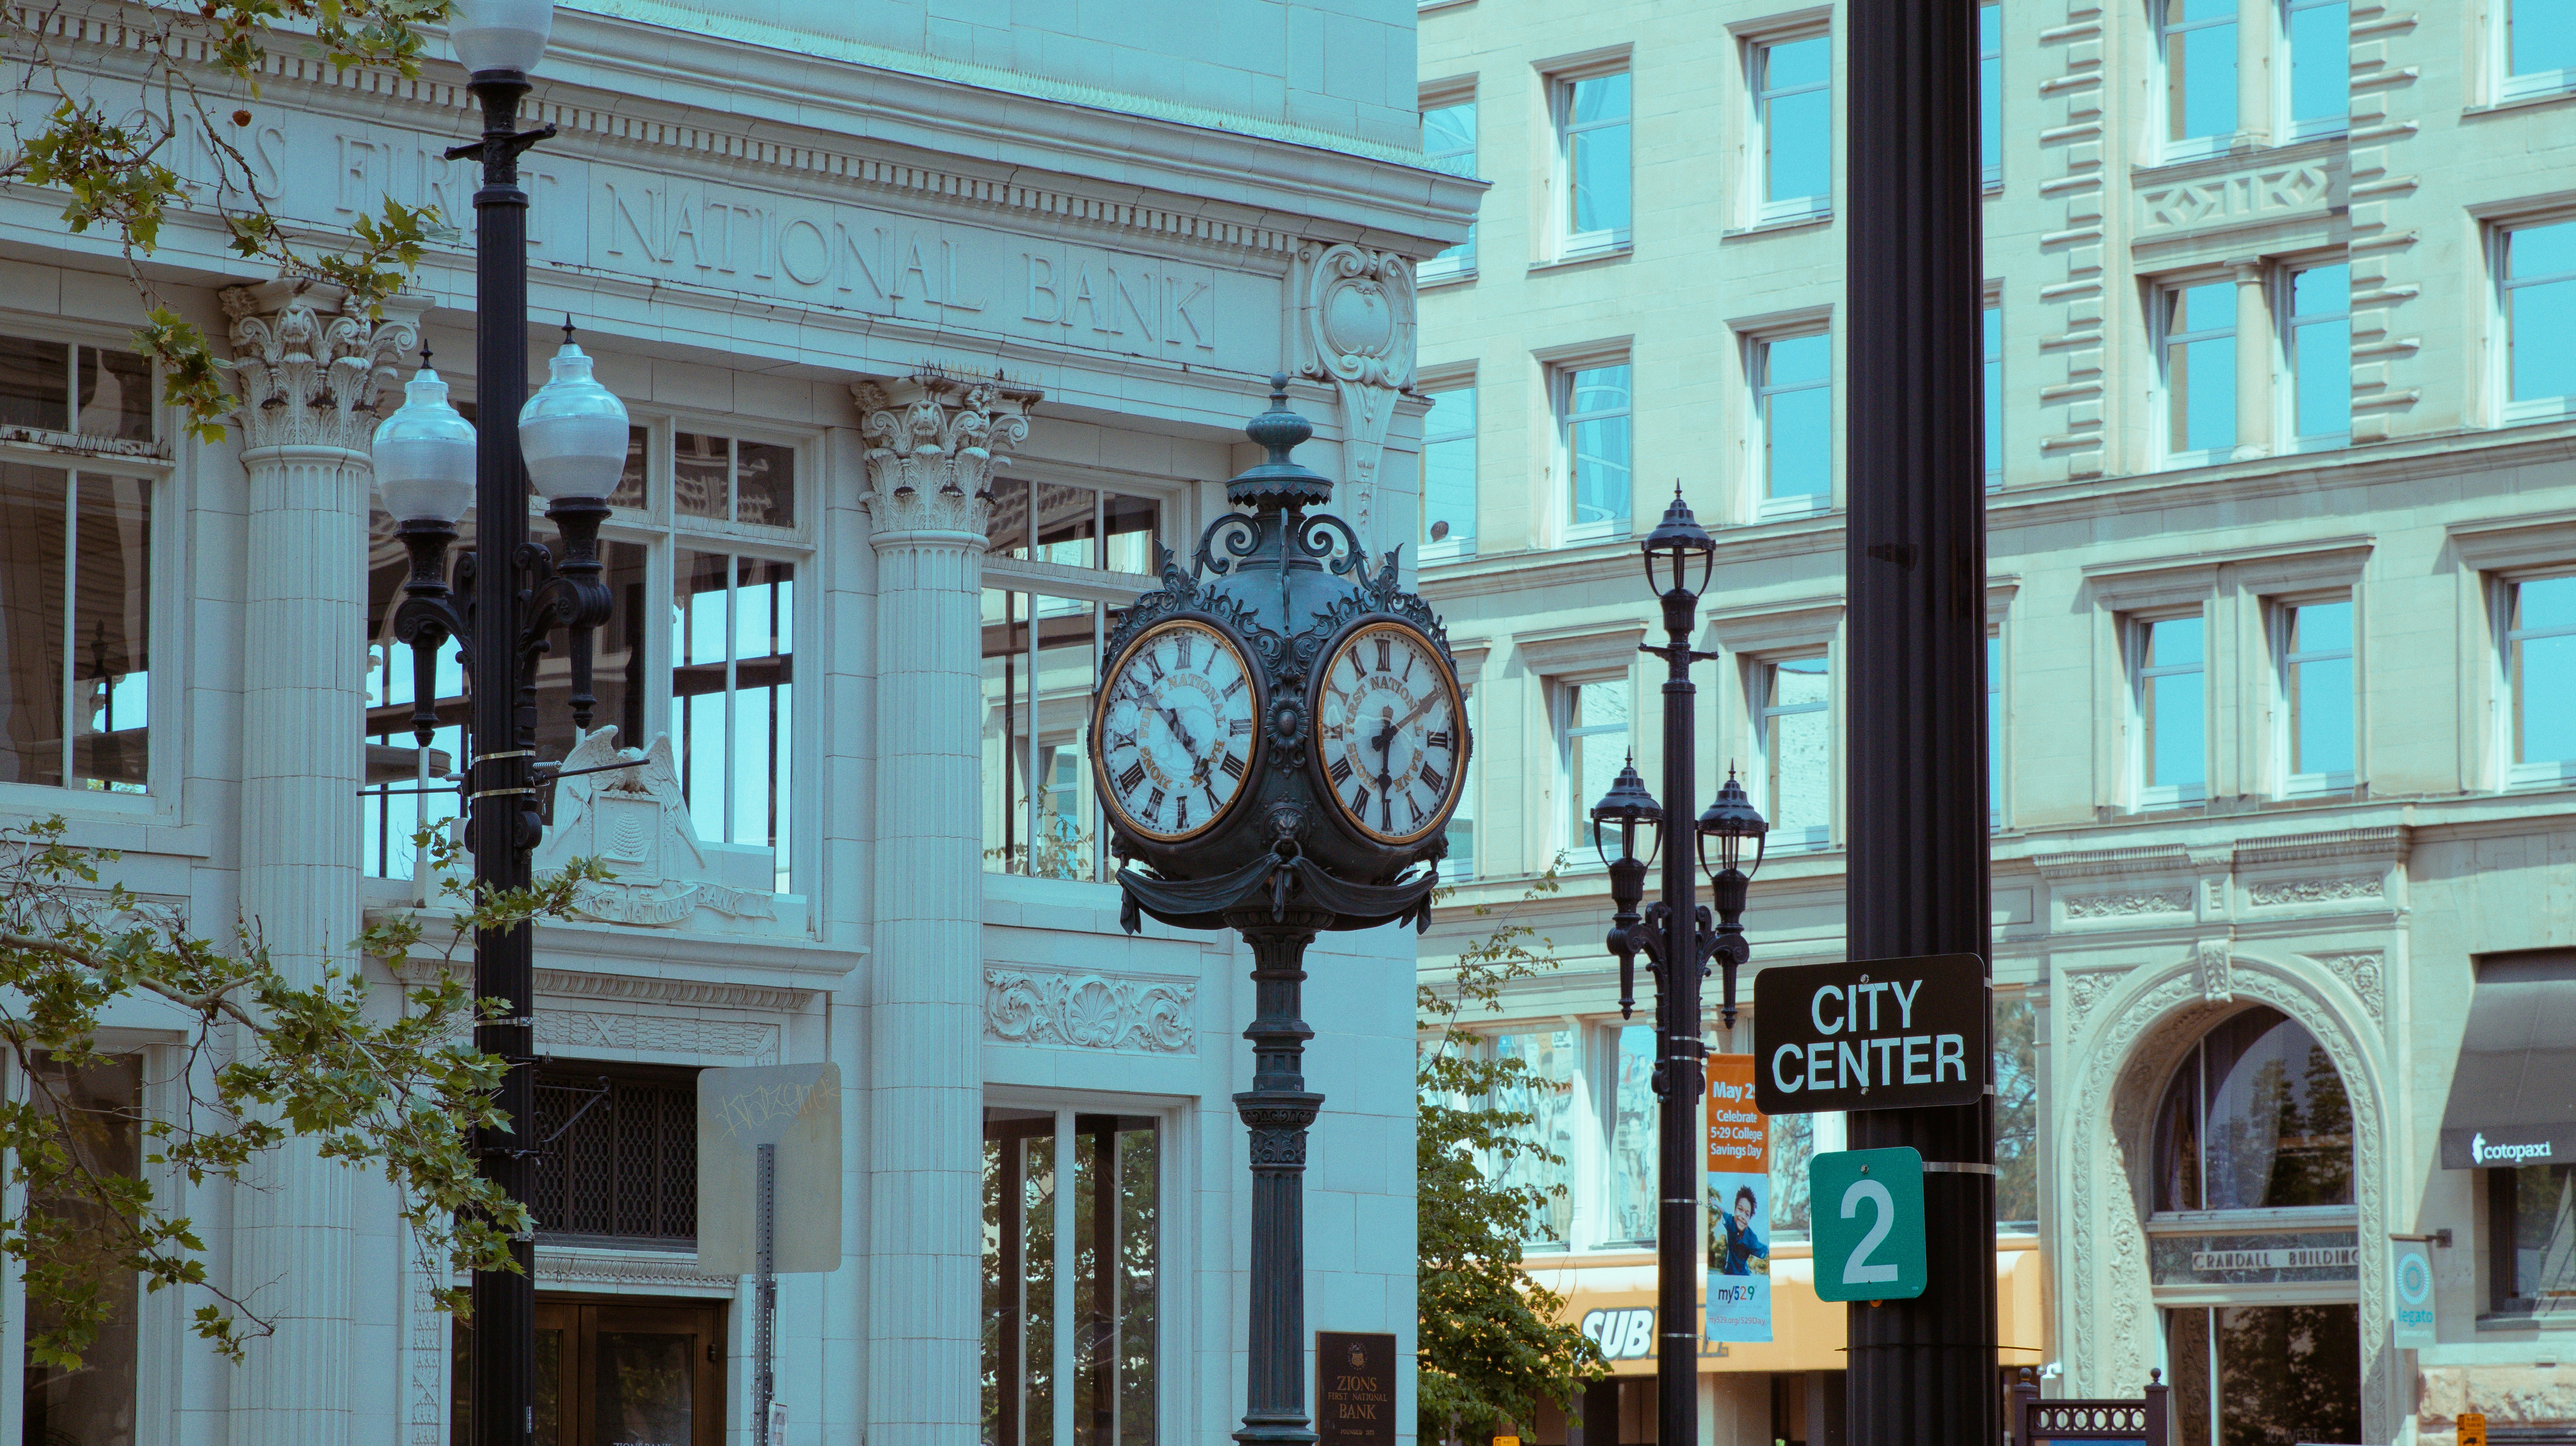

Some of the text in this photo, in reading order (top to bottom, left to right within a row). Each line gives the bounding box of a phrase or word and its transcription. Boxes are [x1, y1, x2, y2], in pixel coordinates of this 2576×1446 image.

[605, 181, 987, 312] NATIONAL
[1022, 252, 1215, 349] BANK
[1175, 636, 1192, 670] XII
[1345, 645, 1367, 682] XI
[1375, 639, 1391, 672] XII
[1345, 683, 1368, 735] FIRST
[1139, 673, 1226, 790] ZIONS FIRT NATIONAL BAK
[1427, 730, 1448, 750] III
[1346, 742, 1377, 790] ZIONS
[1393, 748, 1424, 793] BANK
[697, 884, 742, 916] BANK
[1812, 979, 1923, 1036] CITY
[1772, 1033, 1967, 1094] CENTER
[1713, 1081, 1755, 1103] May 2
[1717, 1109, 1757, 1123] Celebrate
[1732, 1127, 1763, 1142] College
[1710, 1142, 1763, 1159] Savings Day
[2484, 1141, 2552, 1163] cotopaxi
[1841, 1179, 1898, 1284] 2
[2193, 1252, 2271, 1269] CRANDALL
[1718, 1285, 1755, 1304] my529
[2398, 1306, 2433, 1328] legato
[1328, 1392, 1388, 1402] FIRST NATIONAL
[1337, 1376, 1377, 1391] ZIONS
[1340, 1403, 1376, 1419] BANK
